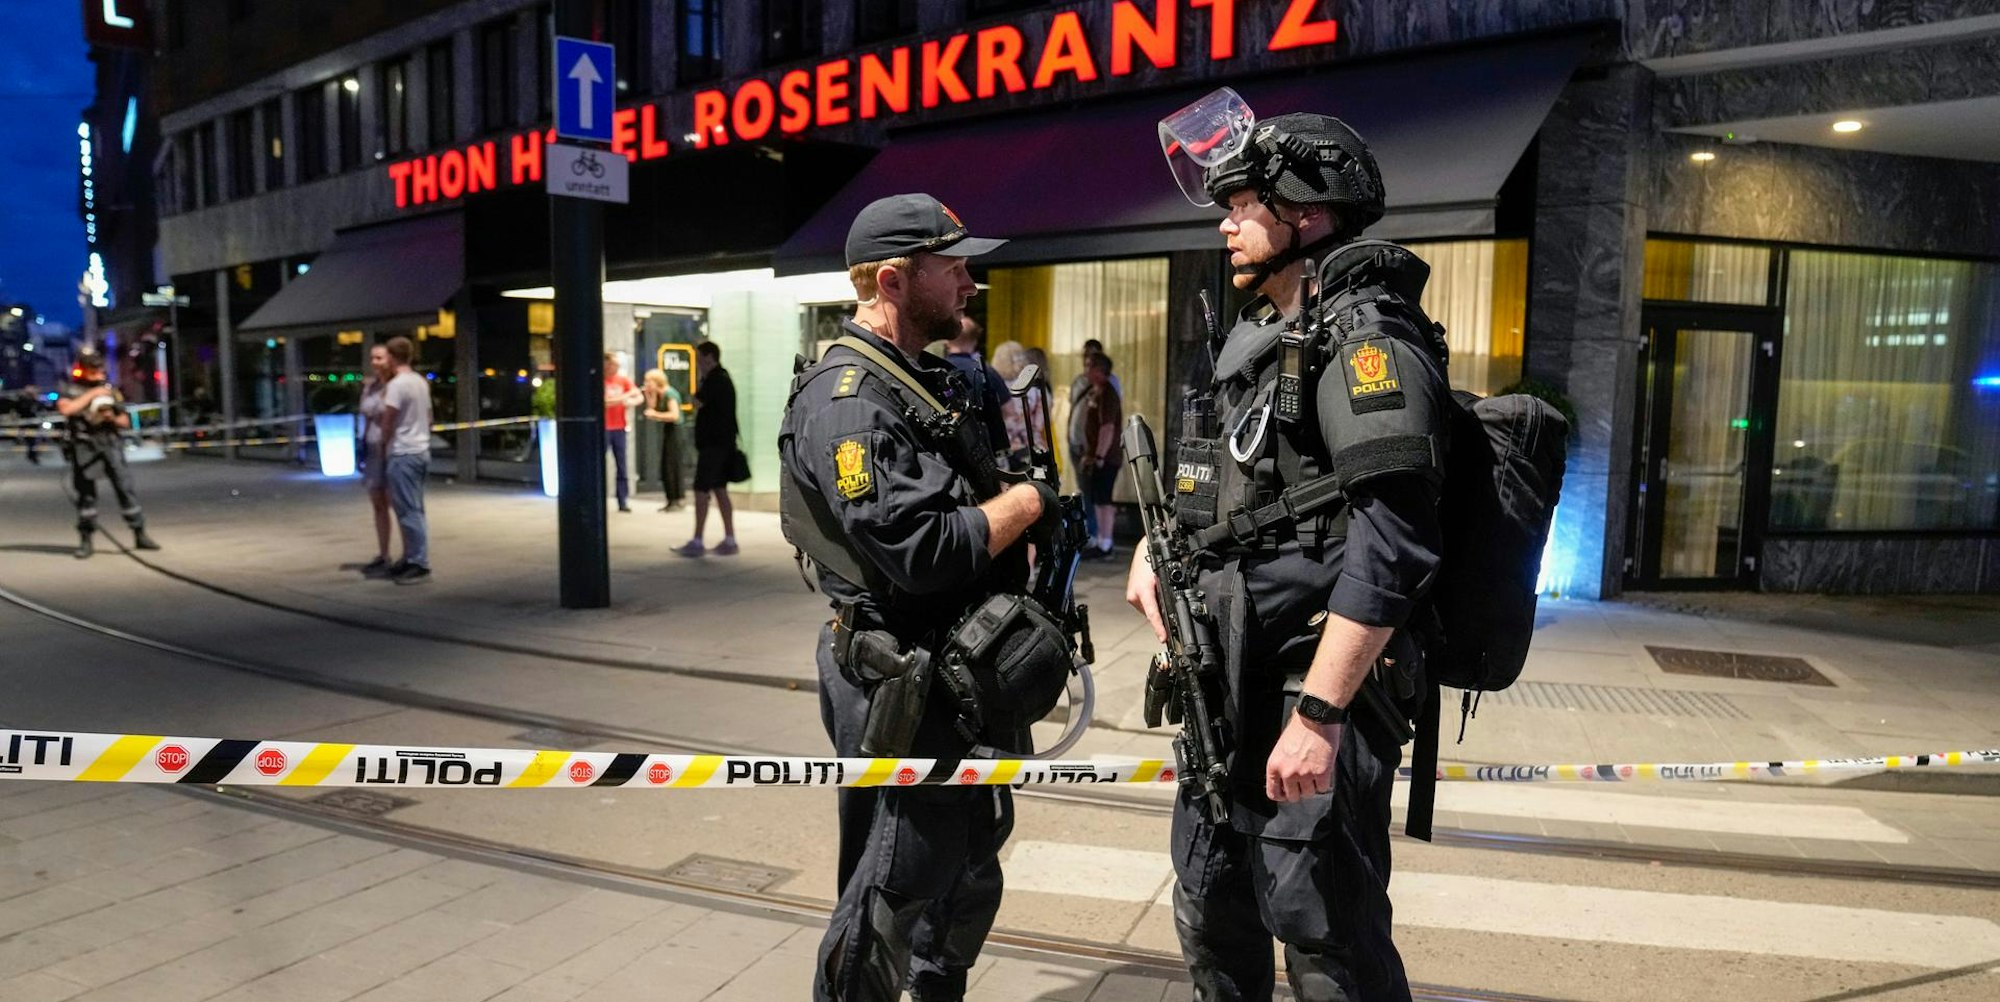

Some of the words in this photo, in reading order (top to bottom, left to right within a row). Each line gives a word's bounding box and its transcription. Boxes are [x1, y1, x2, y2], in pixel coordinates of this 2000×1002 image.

[388, 142, 496, 208] THON
[511, 104, 669, 185] HEL
[694, 0, 1338, 149] ROSENKRANTZ
[1352, 379, 1397, 396] POLITI
[1176, 463, 1211, 481] POLITI
[836, 472, 869, 491] POLITI
[0, 734, 73, 766] ITI
[159, 752, 188, 764] STOP
[258, 756, 284, 768] STOP
[356, 756, 503, 786] POLITI
[571, 767, 593, 778] STOP
[649, 768, 670, 780] STOP
[727, 760, 844, 785] POLITI
